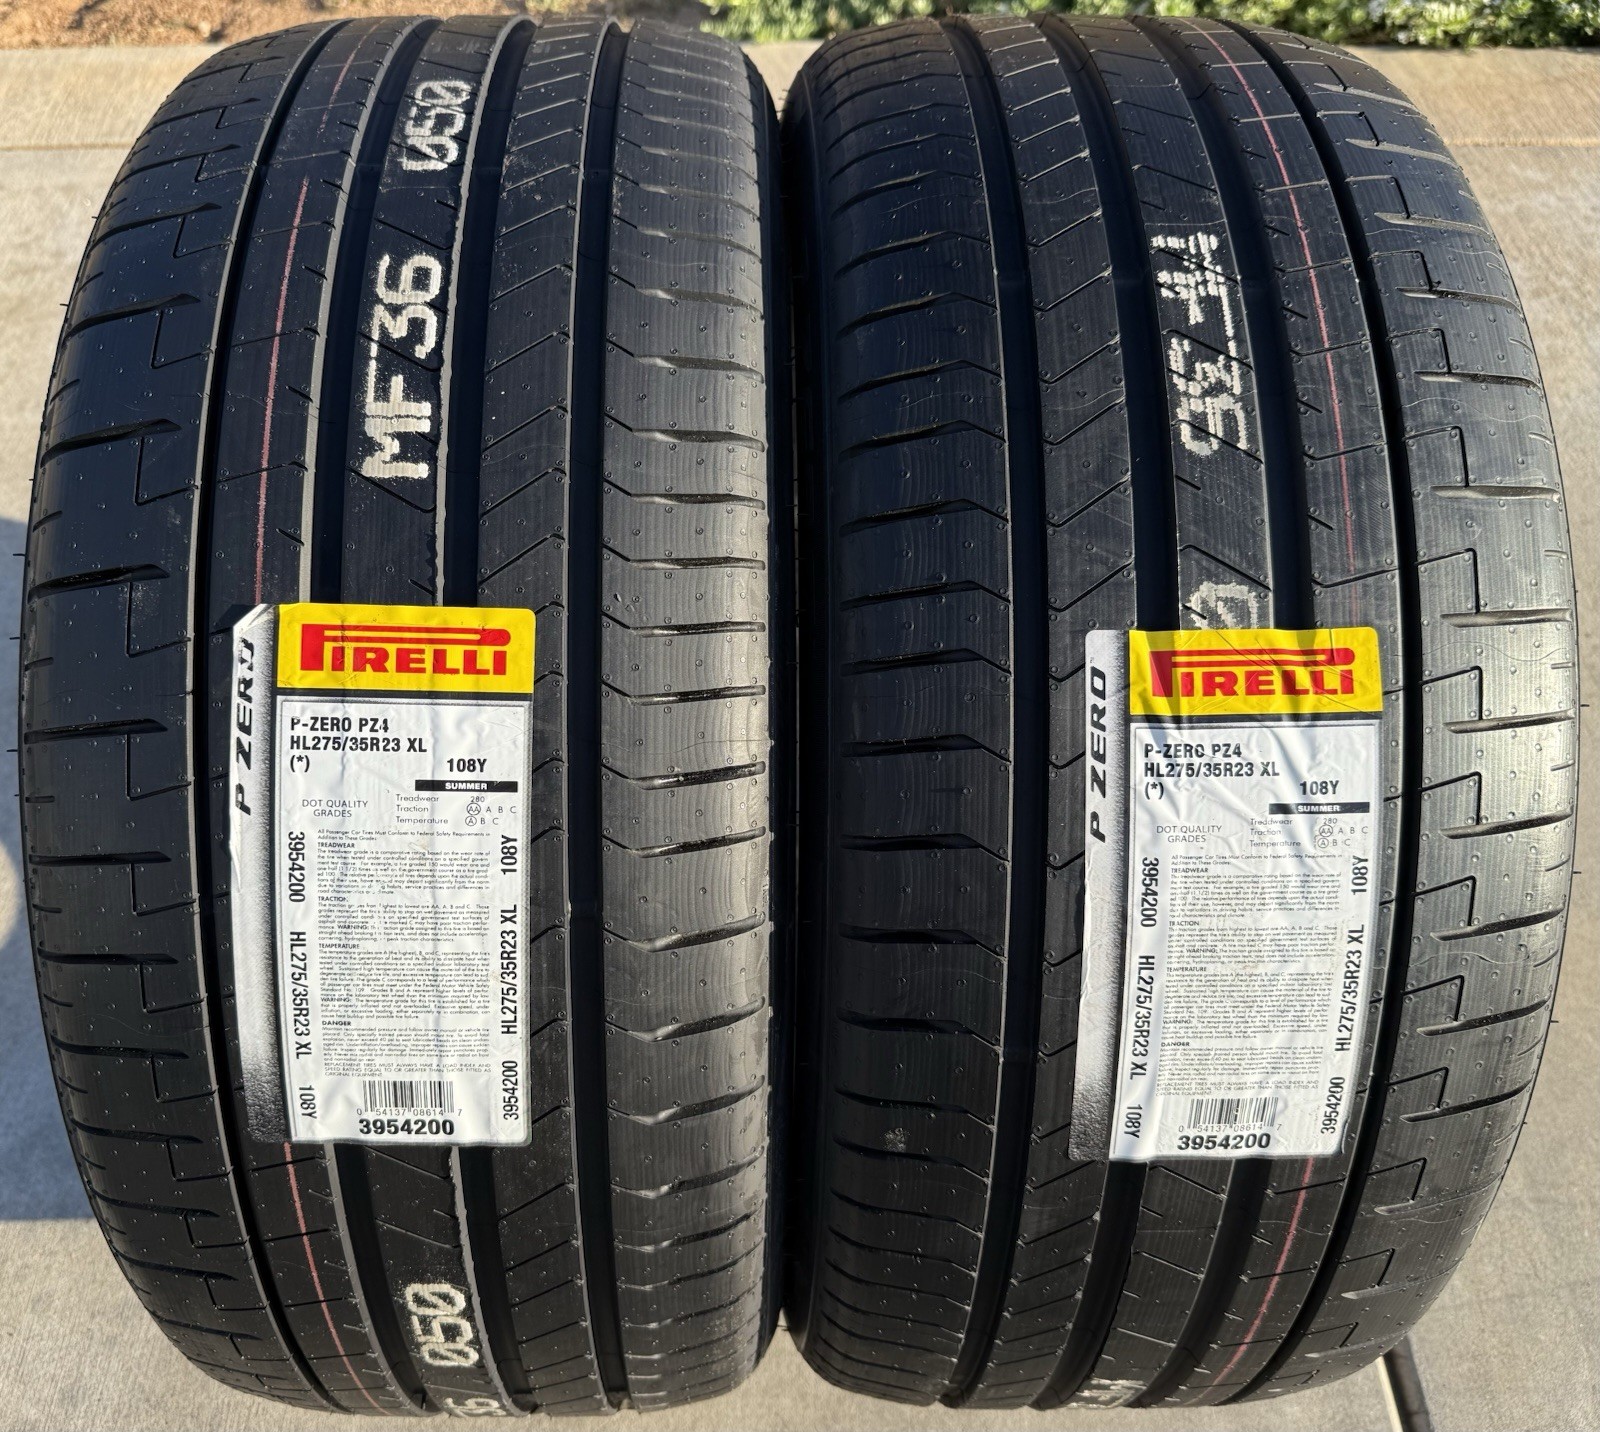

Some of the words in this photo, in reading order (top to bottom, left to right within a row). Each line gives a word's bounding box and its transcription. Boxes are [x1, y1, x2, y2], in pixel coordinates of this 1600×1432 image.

[361, 252, 443, 478] MF36
[300, 623, 511, 675] PIRELLI
[1149, 648, 1355, 698] PIRELLI
[290, 717, 351, 732] P-ZERO
[358, 717, 389, 733] PZ4
[1090, 667, 1107, 798] ZERO
[290, 736, 401, 752] HL275/35R23
[407, 737, 428, 753] XL
[1144, 743, 1205, 759] P-ZERO
[1212, 743, 1242, 758] PZ4
[447, 758, 488, 773] 108Y
[1144, 762, 1254, 778] HL275/35R23
[1260, 761, 1280, 777] XL
[445, 782, 488, 790] SUMMER
[1300, 780, 1340, 796] 108Y
[235, 783, 252, 816] P
[302, 799, 323, 808] DOT
[326, 800, 369, 808] QUALITY
[396, 794, 440, 802] Treadwear
[313, 809, 352, 818] GRADES
[396, 805, 429, 813] Traction
[510, 806, 517, 814] C
[396, 816, 449, 825] Temperature
[481, 817, 486, 825] B
[492, 817, 499, 825] C
[1090, 811, 1106, 844] P
[1156, 826, 1178, 834] DOT
[1180, 825, 1222, 834] QUALITY
[1167, 835, 1207, 843] GRADES
[1250, 828, 1282, 836] Traction
[1362, 826, 1369, 834] C
[1250, 840, 1301, 848] Temperature
[501, 835, 518, 875] 108Y
[289, 831, 305, 903] 3954200
[1351, 855, 1369, 895] 108Y
[1141, 857, 1160, 927] 3954200
[500, 904, 517, 925] XL
[1348, 924, 1365, 945] XL
[289, 931, 310, 1037] HL275/35R23
[500, 929, 518, 1035] HL275/35R23
[1133, 955, 1156, 1057] HL275/35R23
[1335, 950, 1362, 1052] HL275/35R23
[295, 1040, 312, 1060] XL
[1130, 1061, 1148, 1080] XL
[502, 1060, 519, 1121] 3954200
[299, 1085, 317, 1119] 108Y
[1321, 1076, 1346, 1134] 3954200
[357, 1108, 362, 1116] 0
[375, 1108, 407, 1116] 54137
[413, 1108, 444, 1116] 08614
[457, 1109, 463, 1117] 7
[1124, 1103, 1143, 1139] 108Y
[359, 1118, 455, 1136] 3954200
[1178, 1125, 1185, 1133] 0
[1197, 1124, 1227, 1133] 54137
[1233, 1123, 1263, 1132] 08614
[1276, 1123, 1282, 1131] 7
[1177, 1133, 1271, 1150] 3954200
[404, 1283, 480, 1367] 050
